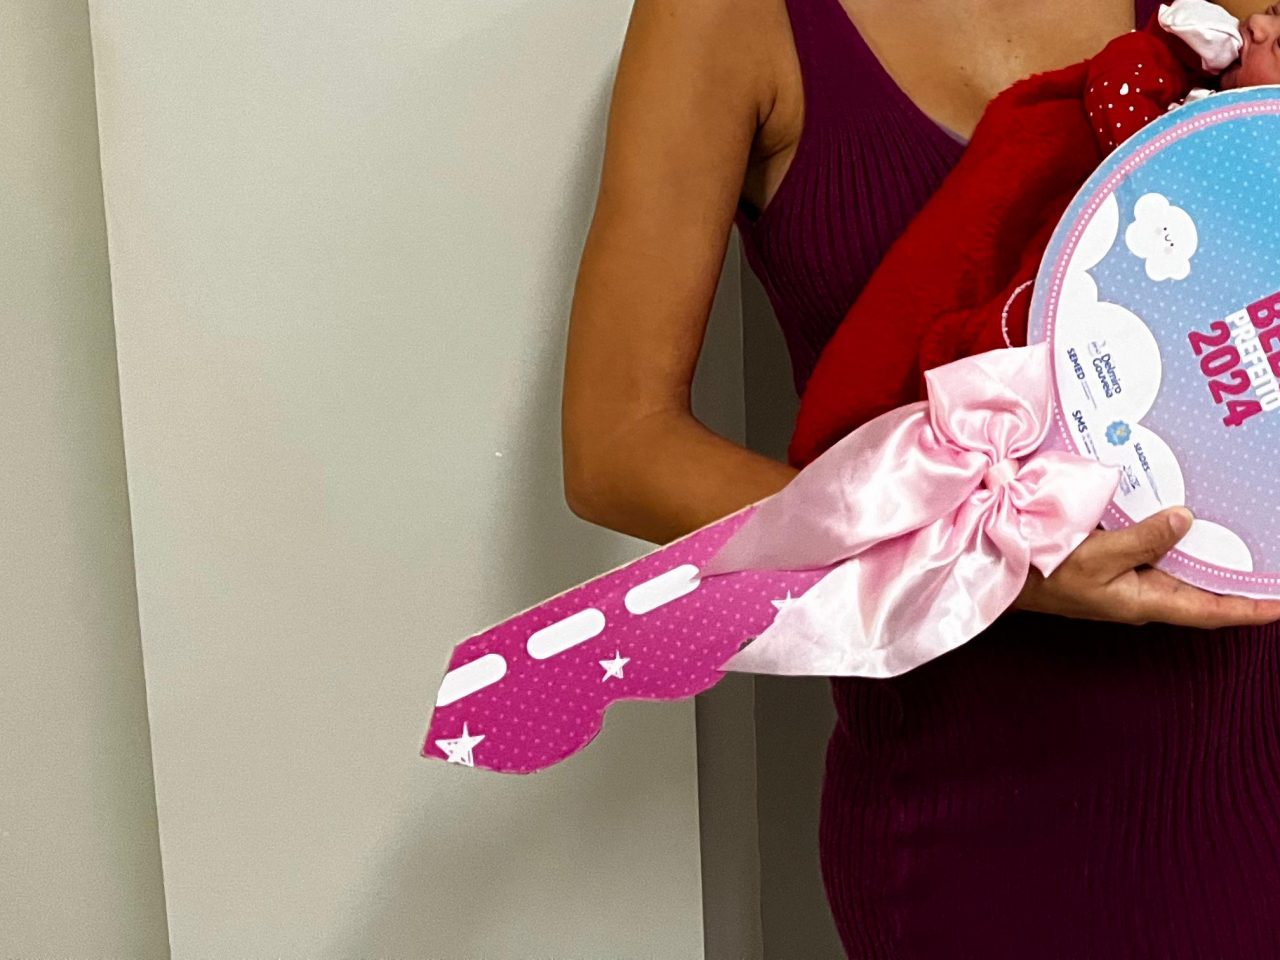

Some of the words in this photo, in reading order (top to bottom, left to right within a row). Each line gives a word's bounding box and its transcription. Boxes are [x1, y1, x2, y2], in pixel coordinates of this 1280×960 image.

[1067, 347, 1086, 380] SEMED
[1092, 358, 1113, 398] Gouveia
[1101, 353, 1122, 394] Delmiro
[1188, 321, 1263, 427] 2024
[1072, 409, 1088, 433] SMS
